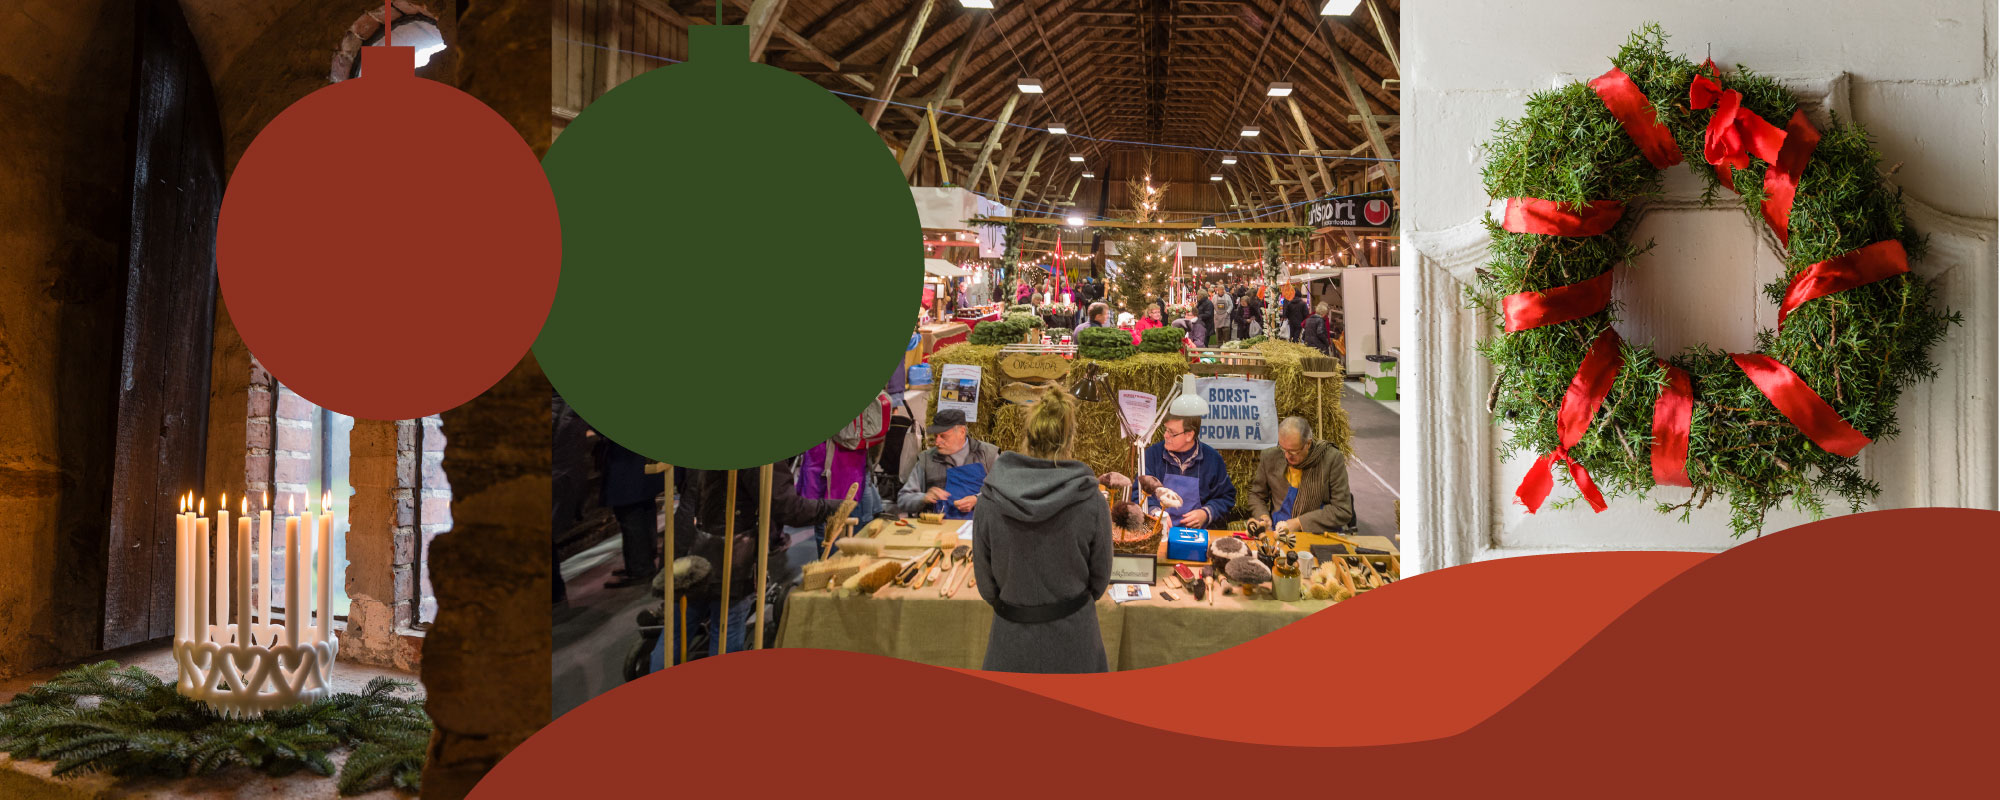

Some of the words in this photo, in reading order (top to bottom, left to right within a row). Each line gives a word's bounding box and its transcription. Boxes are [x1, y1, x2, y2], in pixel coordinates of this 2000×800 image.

[1209, 388, 1256, 402] BORST-
[1201, 405, 1259, 420] INDNING
[1199, 425, 1240, 440] PROVA
[1245, 422, 1261, 440] PÅ
